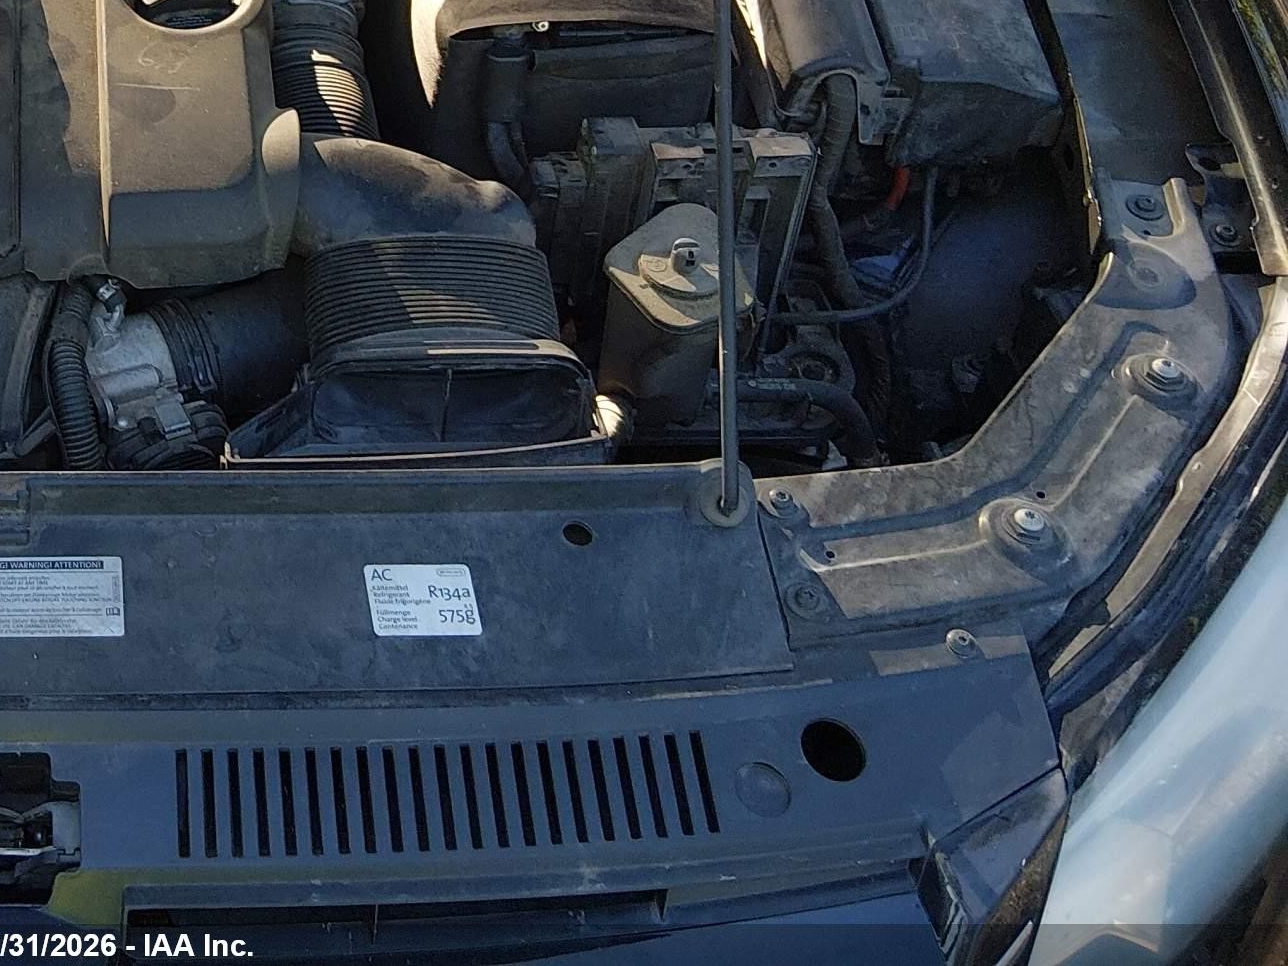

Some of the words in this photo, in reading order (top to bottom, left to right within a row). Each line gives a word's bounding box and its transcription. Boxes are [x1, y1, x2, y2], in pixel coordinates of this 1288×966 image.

[10, 561, 52, 569] WARNING!
[54, 561, 102, 569] ATTENTION!
[370, 568, 393, 581] AC
[427, 584, 472, 601] R134a
[438, 609, 477, 625] 575g
